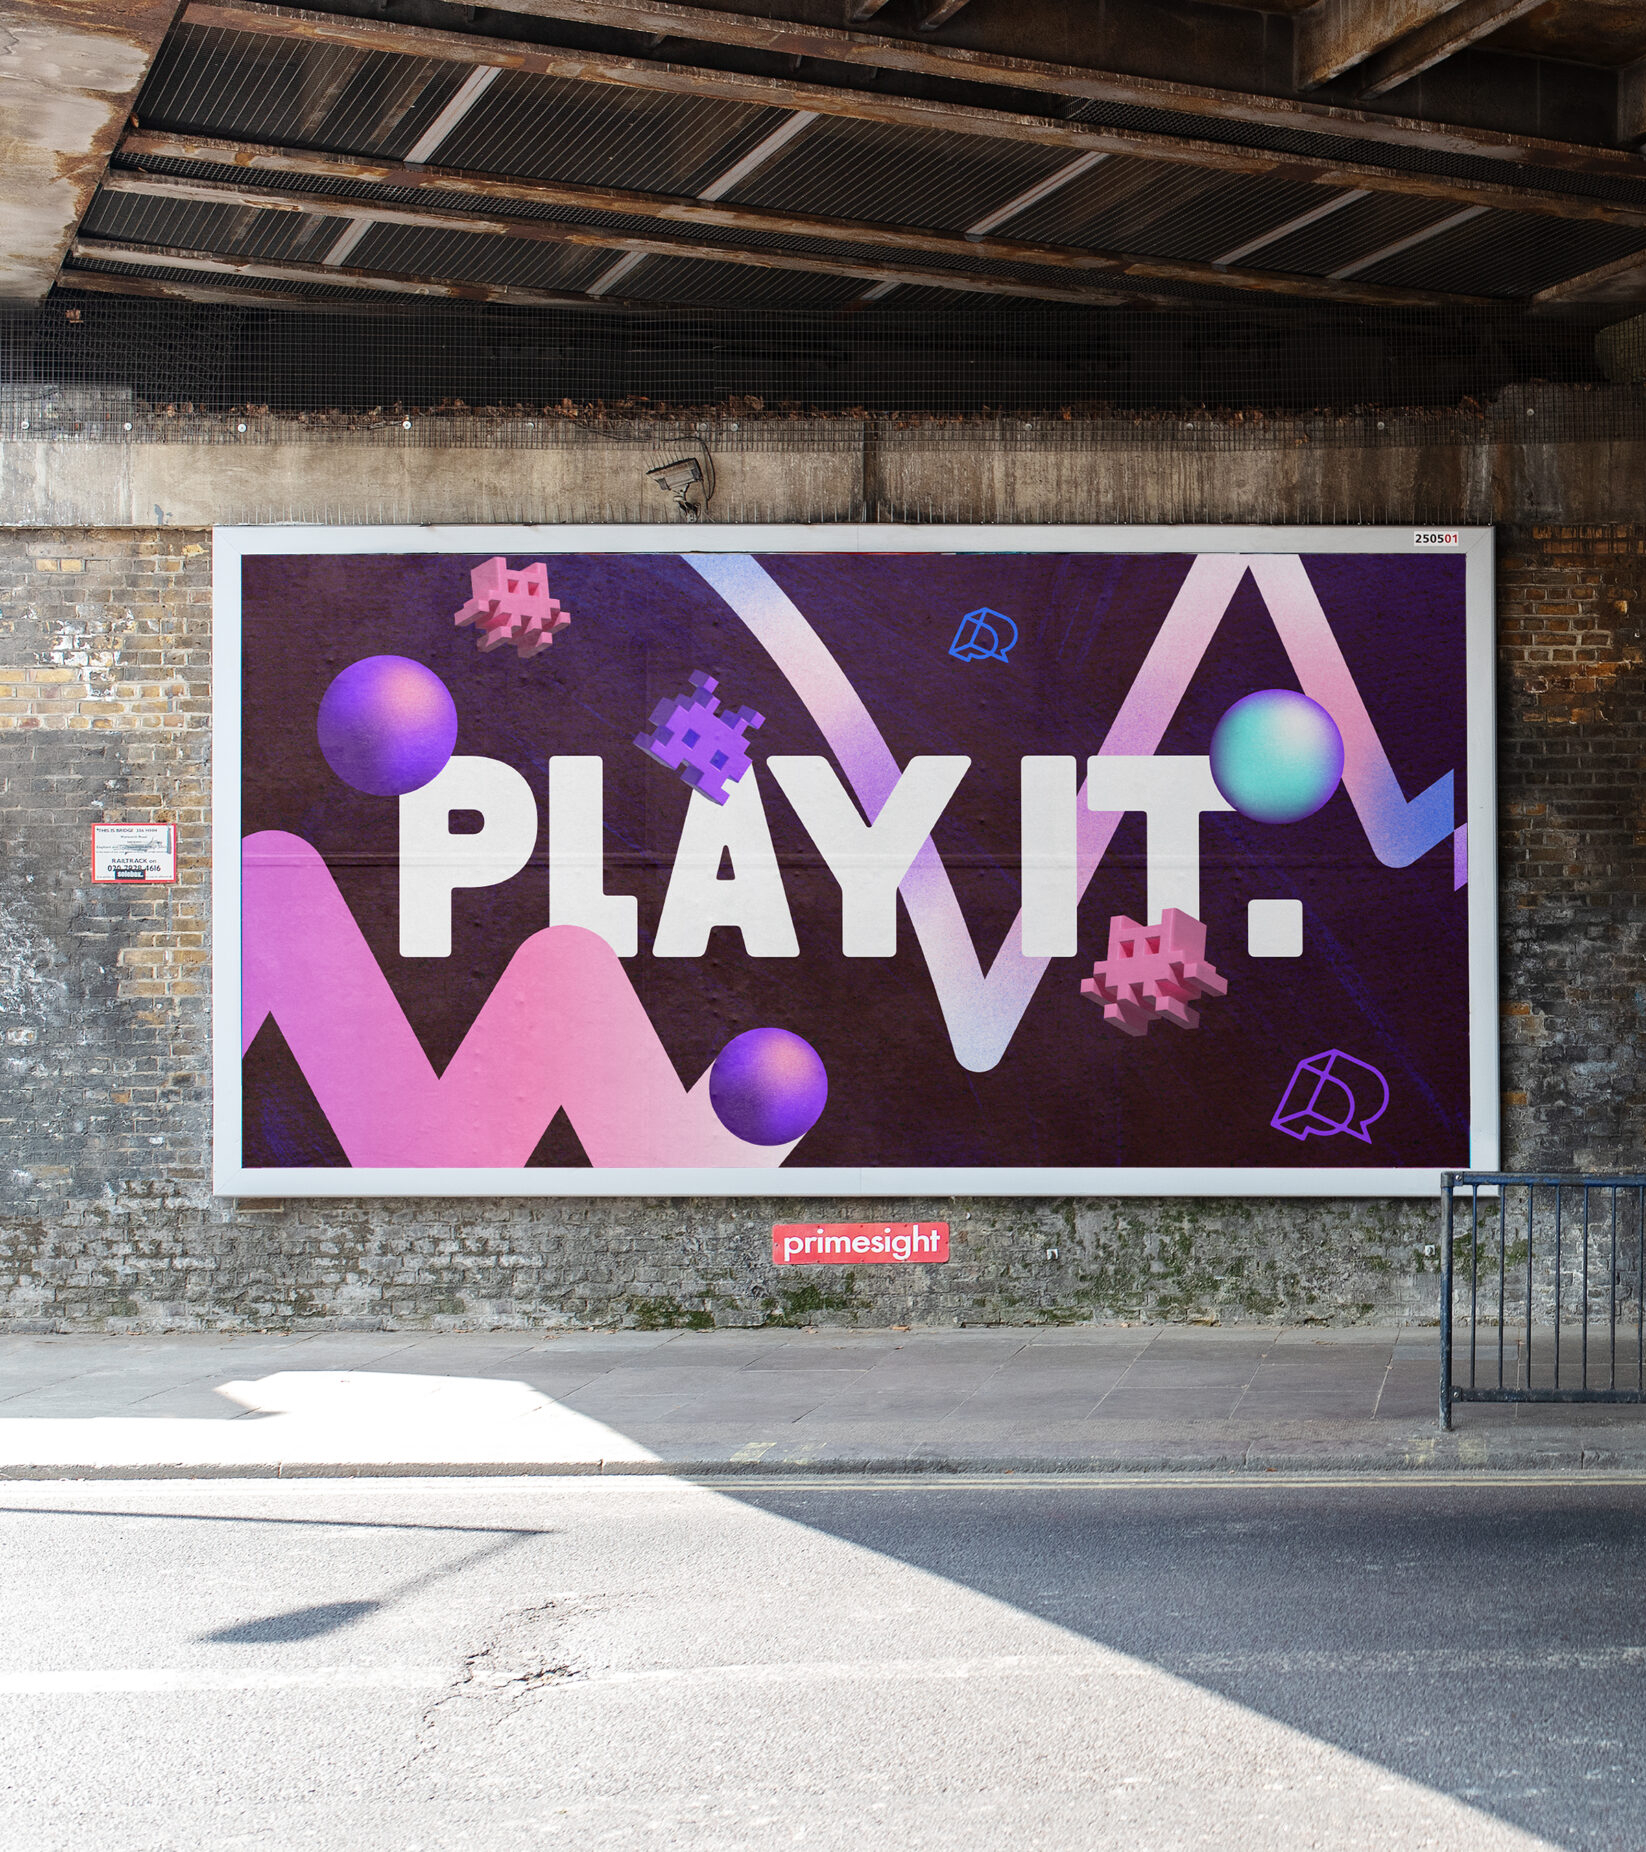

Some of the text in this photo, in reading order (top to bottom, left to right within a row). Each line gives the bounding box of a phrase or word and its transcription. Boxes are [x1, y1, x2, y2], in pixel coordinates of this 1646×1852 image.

[1415, 533, 1458, 544] 250501
[399, 755, 1304, 957] PLAY IT.
[784, 1224, 941, 1262] primesight
